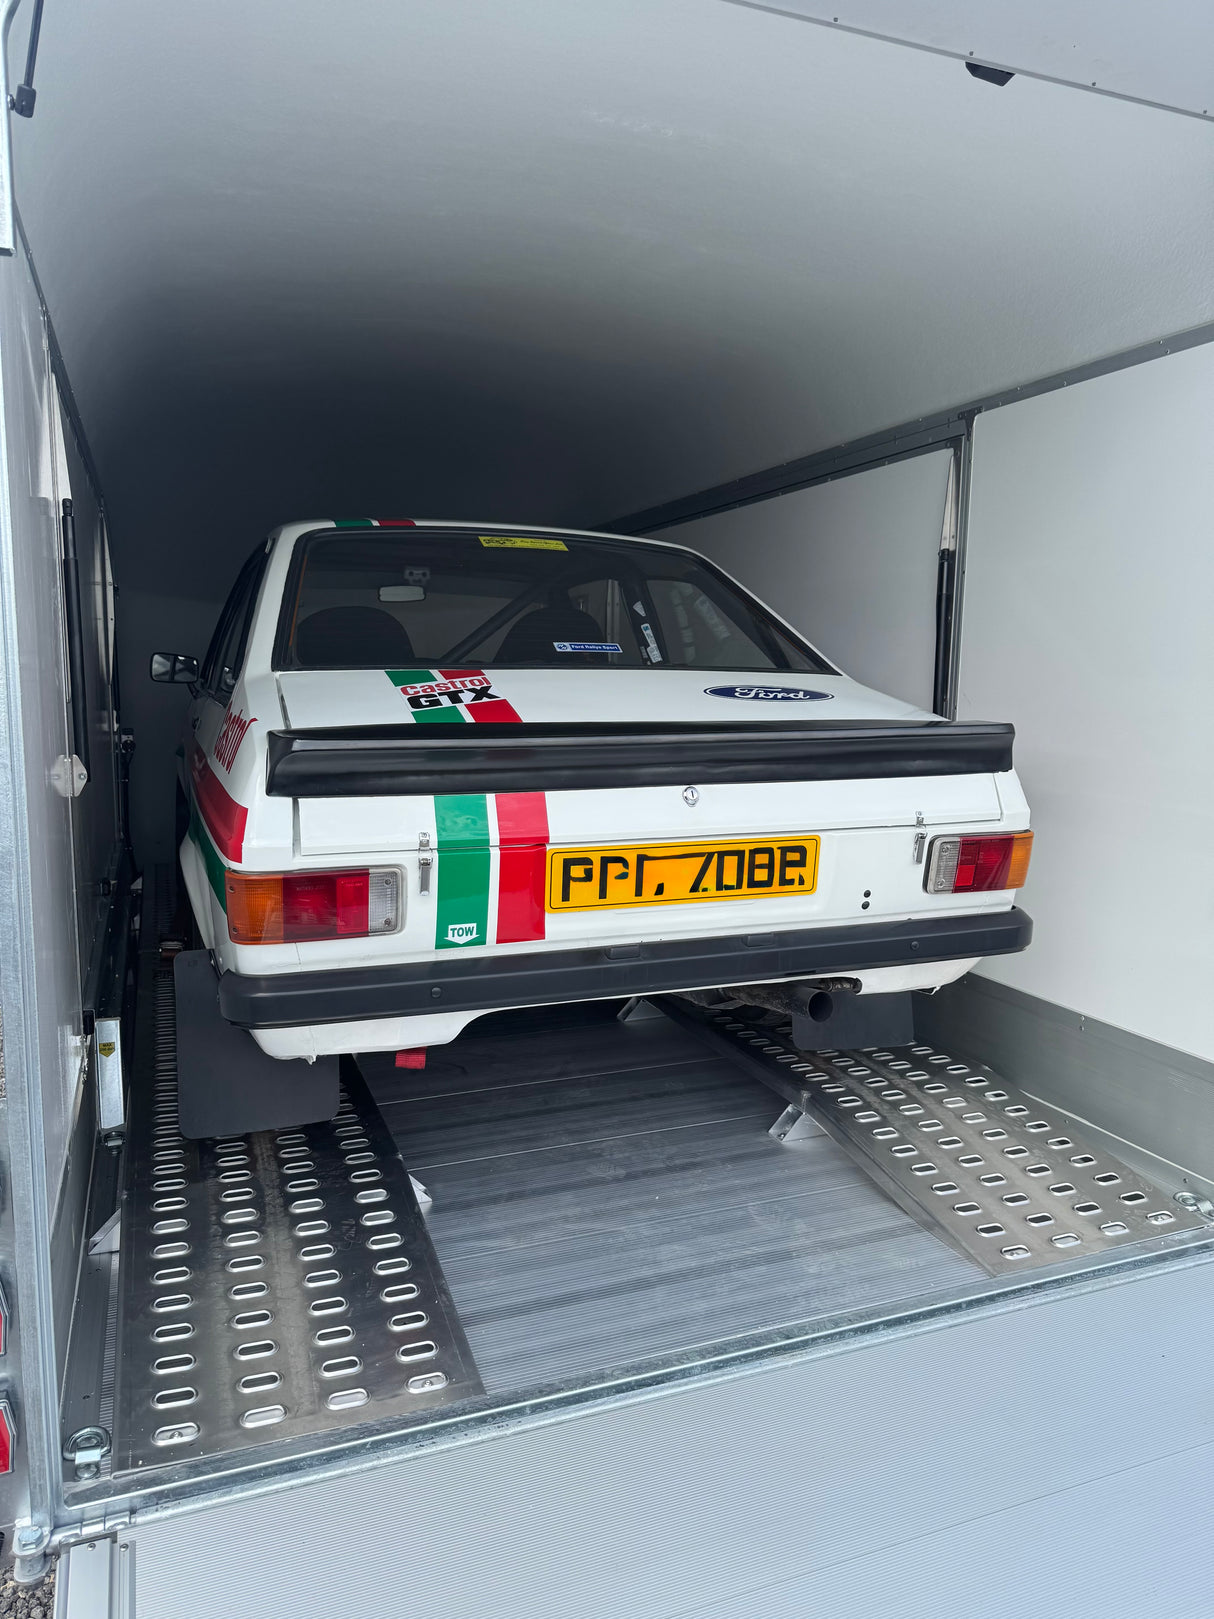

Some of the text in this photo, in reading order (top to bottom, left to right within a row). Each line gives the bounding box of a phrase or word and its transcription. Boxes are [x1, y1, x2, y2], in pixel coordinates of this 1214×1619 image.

[400, 676, 492, 696] Castrol
[734, 687, 810, 699] Ford
[407, 685, 502, 709] GTX
[450, 926, 475, 938] TOW
